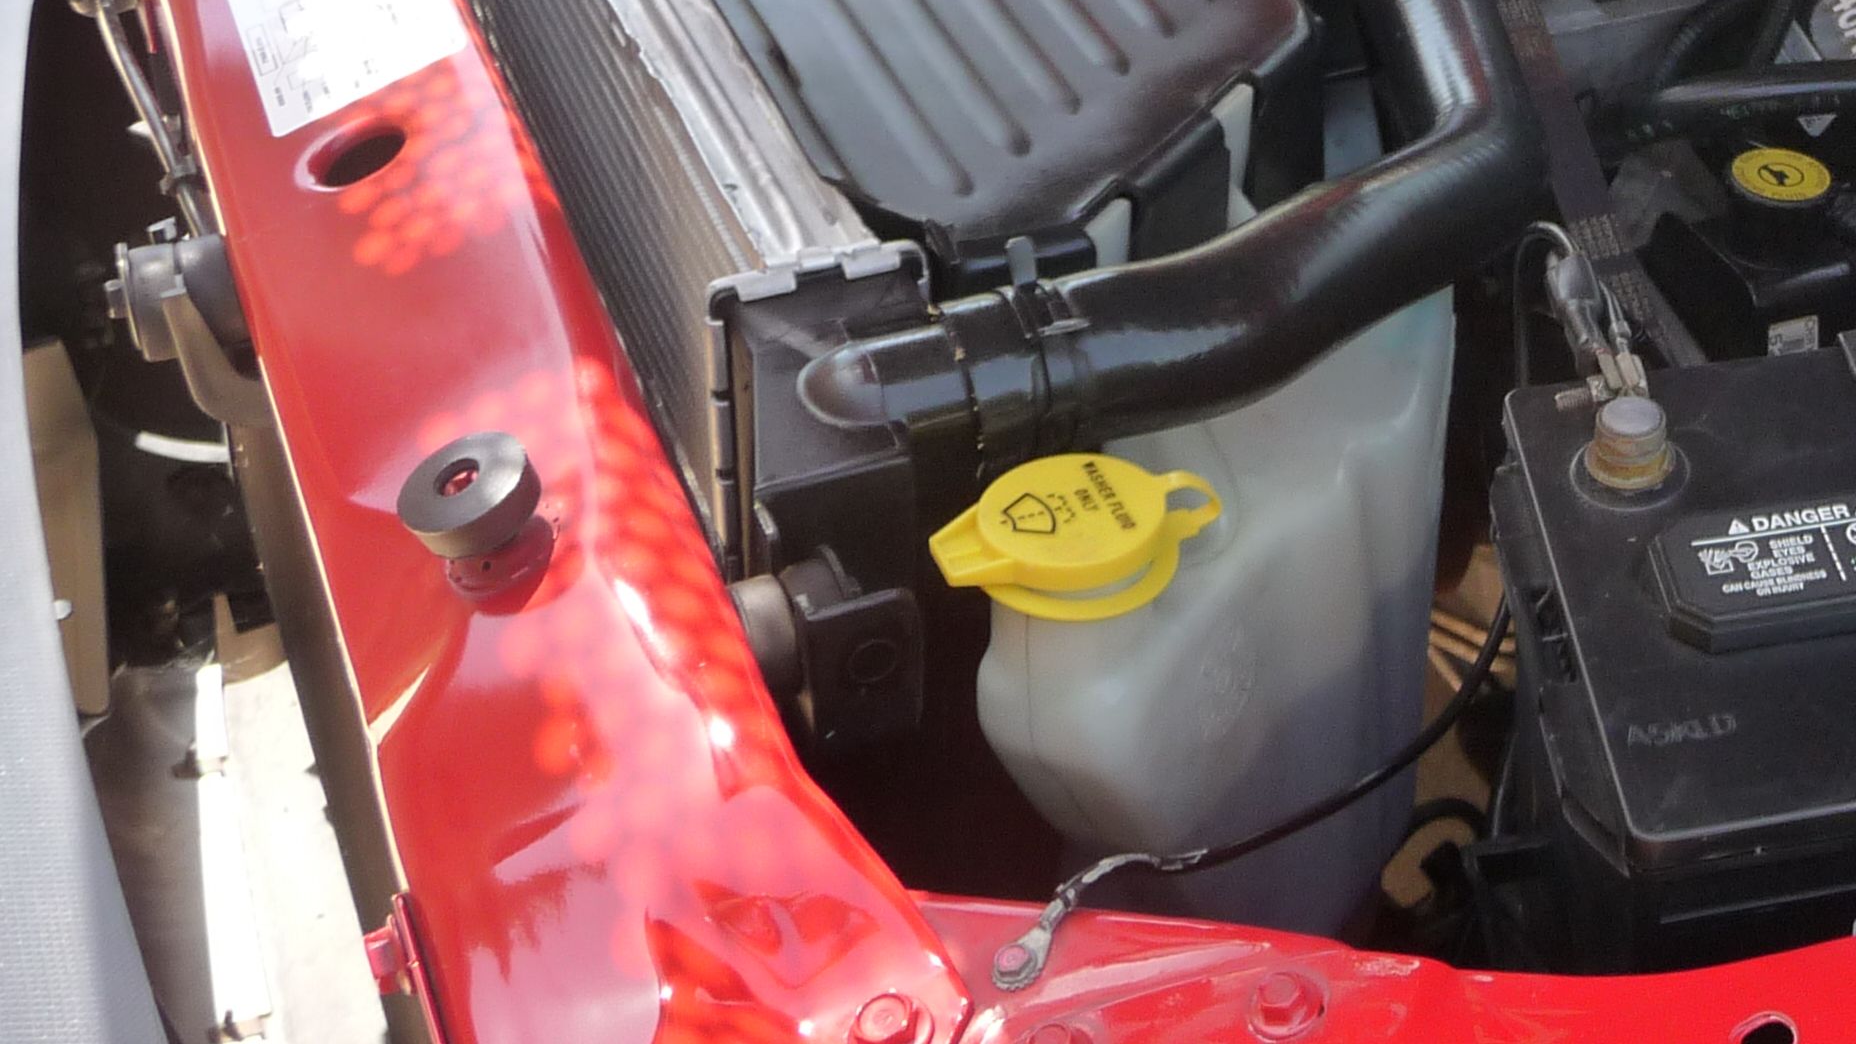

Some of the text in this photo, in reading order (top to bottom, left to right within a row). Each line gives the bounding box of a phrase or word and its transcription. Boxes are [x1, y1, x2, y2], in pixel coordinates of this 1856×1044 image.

[1074, 488, 1100, 513] ONLY
[1081, 460, 1135, 531] WASHER FLUID
[1751, 504, 1850, 531] DANGER
[1769, 534, 1813, 549] SHIELD
[1772, 545, 1805, 558] EYES
[1747, 552, 1815, 571] EXPLOSIVE
[1750, 566, 1793, 579] GASES
